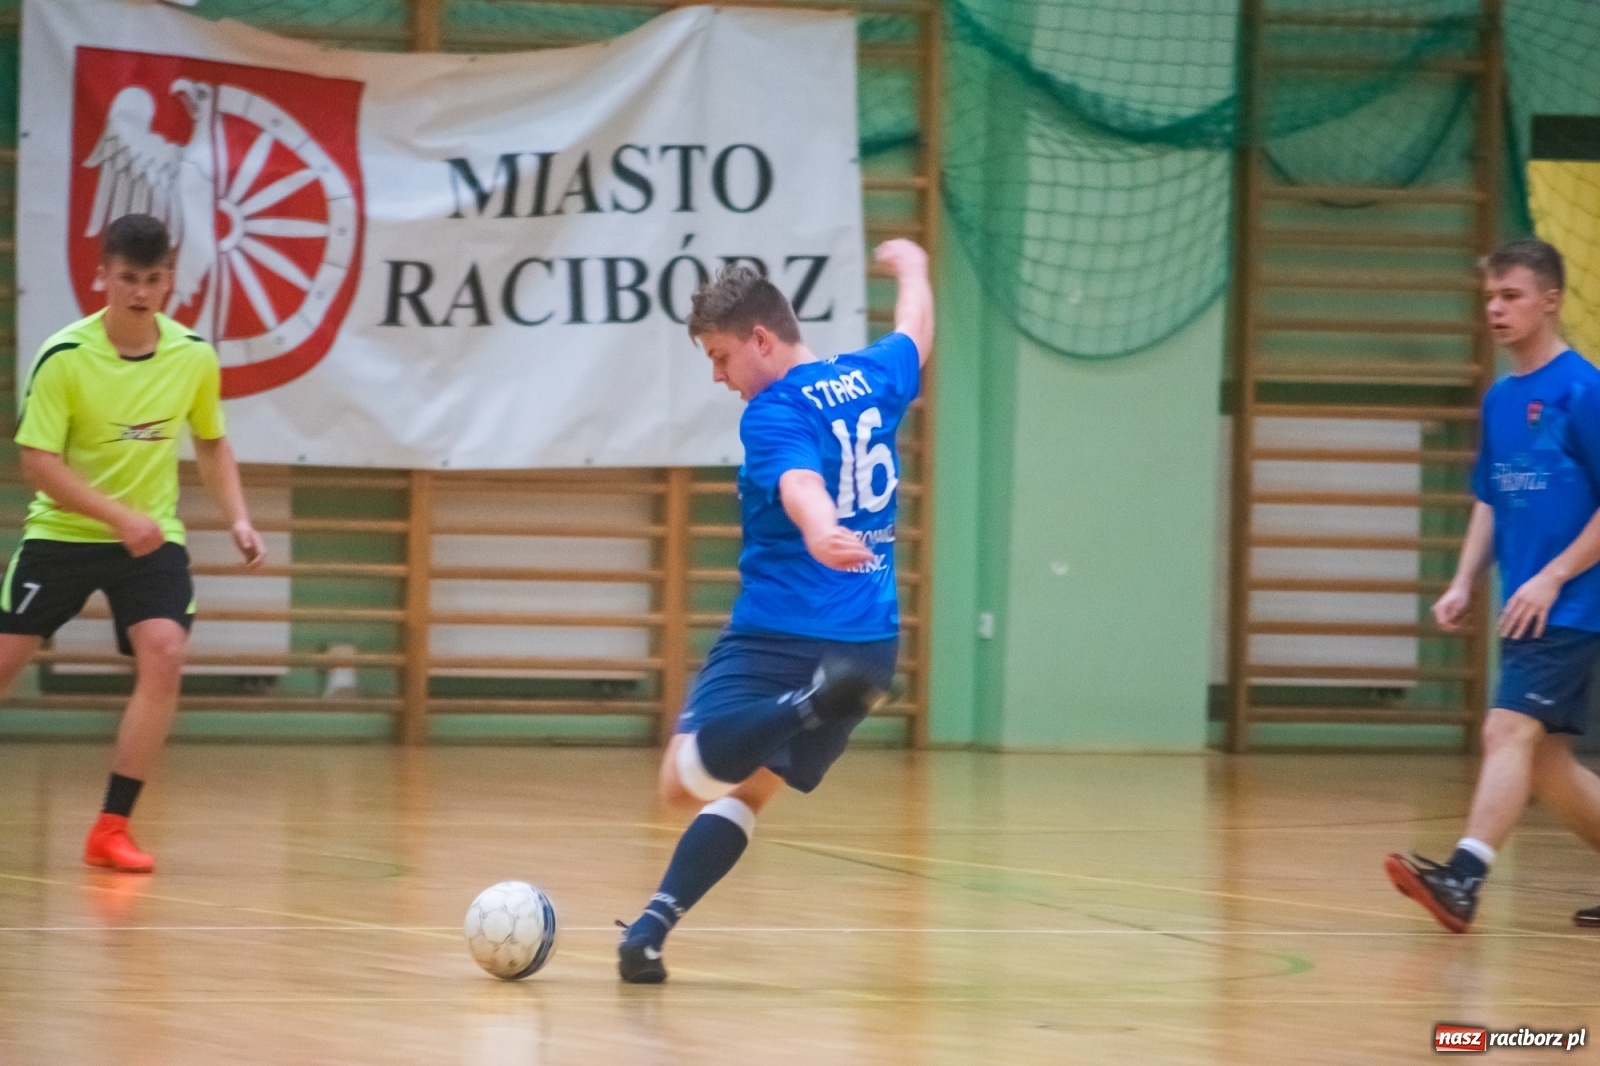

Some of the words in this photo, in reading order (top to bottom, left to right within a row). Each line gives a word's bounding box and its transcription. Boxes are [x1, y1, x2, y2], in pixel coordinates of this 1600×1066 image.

[446, 143, 774, 219] MIASTO
[802, 370, 873, 410] START
[832, 407, 898, 518] 16
[15, 582, 42, 614] 7
